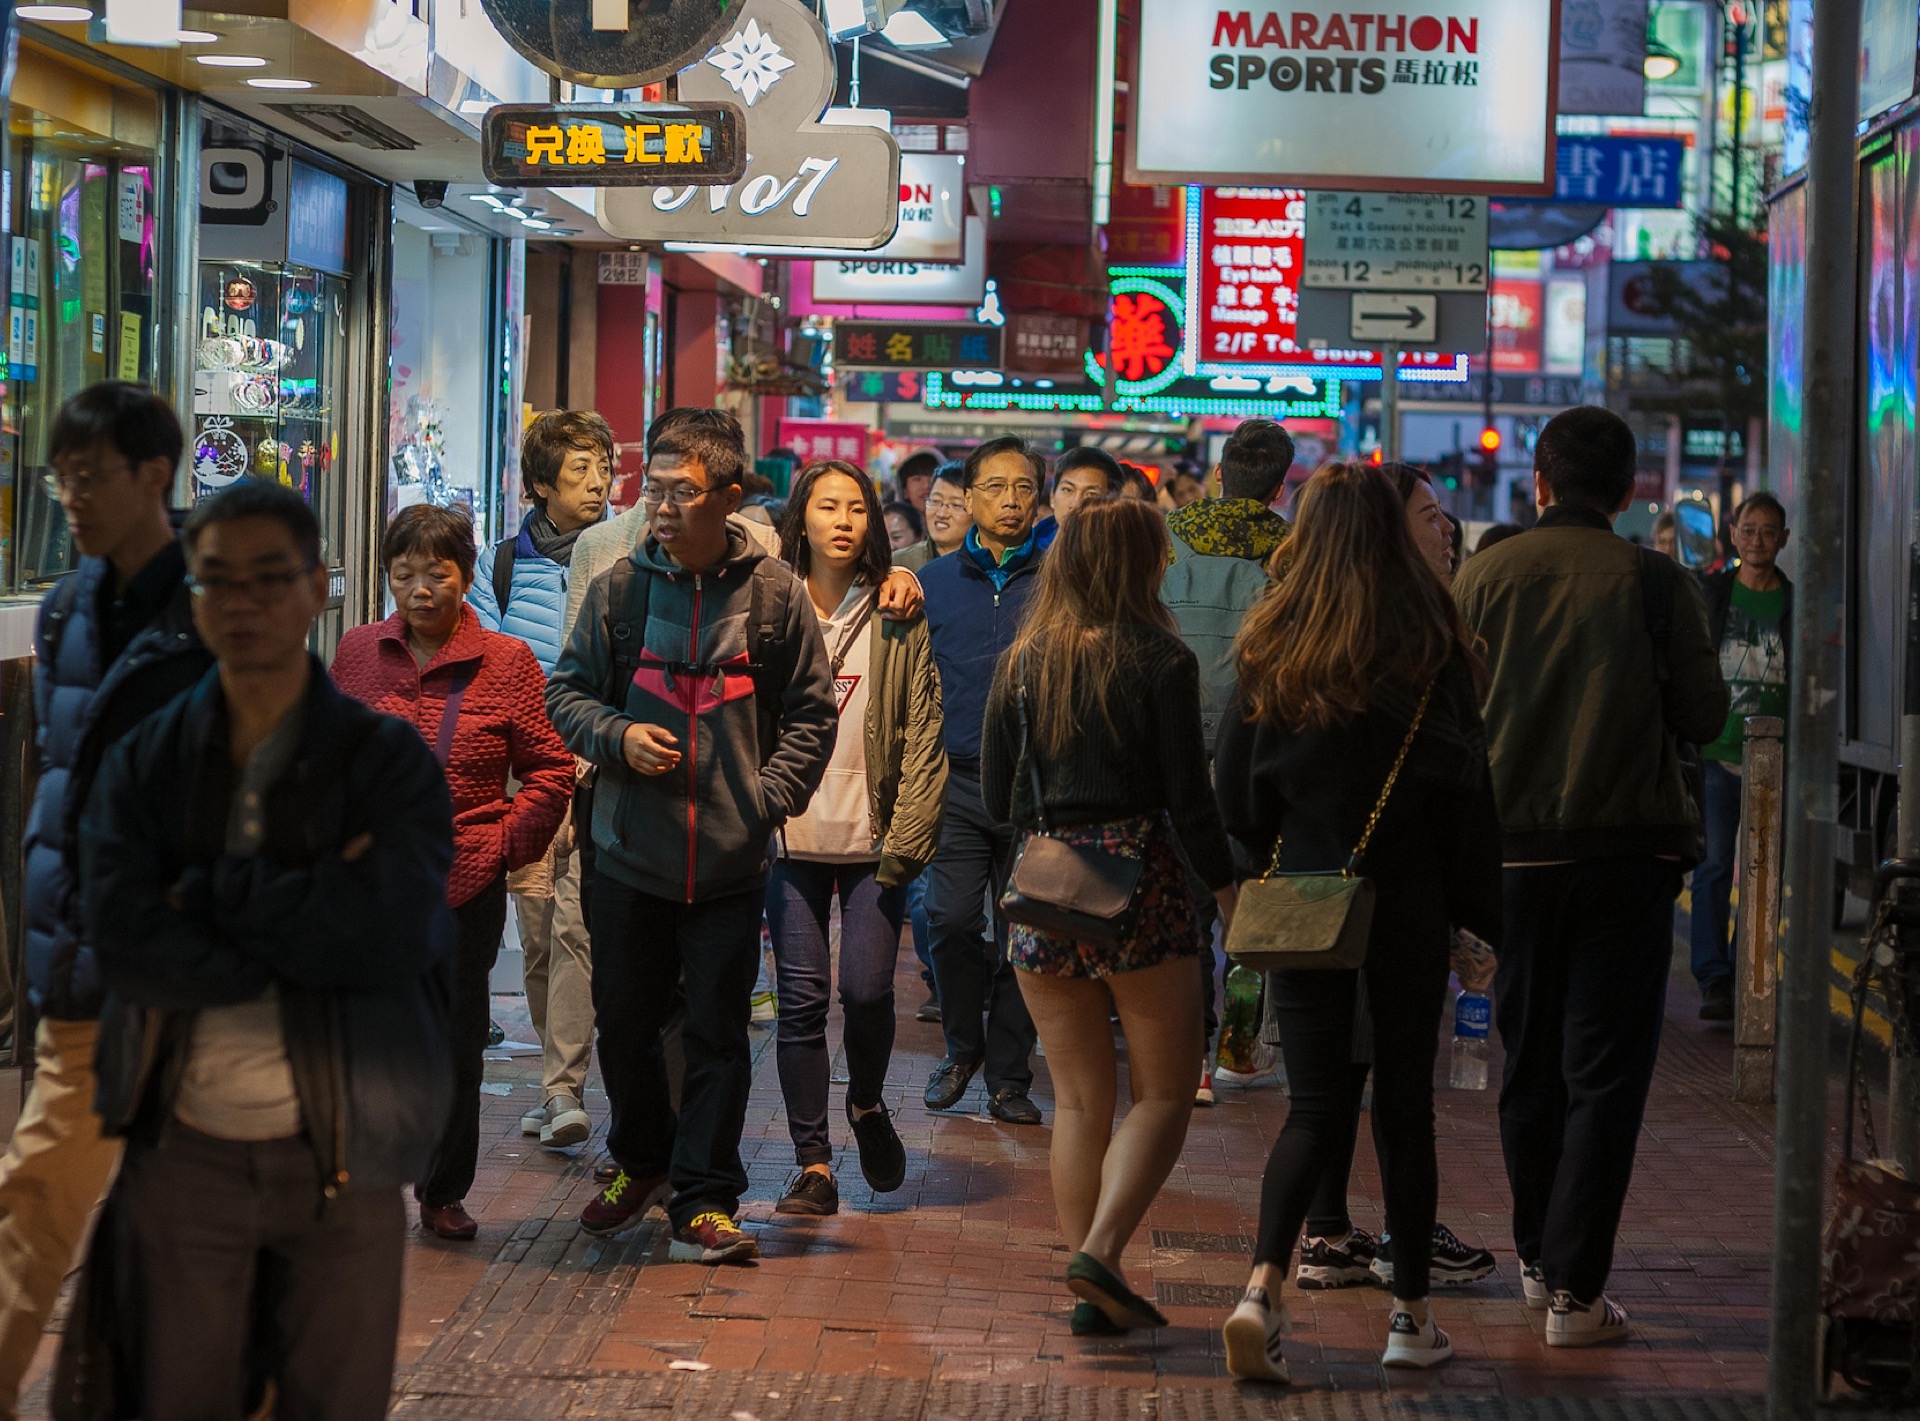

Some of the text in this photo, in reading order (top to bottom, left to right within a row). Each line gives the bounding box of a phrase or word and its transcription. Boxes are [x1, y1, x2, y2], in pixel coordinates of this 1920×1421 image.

[1211, 11, 1479, 54] MARATHON
[1209, 54, 1387, 95] SPORTS
[1392, 58, 1479, 86] 馬拉松
[1345, 196, 1363, 218] 4
[1448, 197, 1477, 219] 12
[1367, 221, 1412, 233] General
[1416, 223, 1466, 235] Holidays
[1342, 260, 1370, 282] 12
[1455, 263, 1483, 285] 12
[1214, 332, 1258, 355] 2/F
